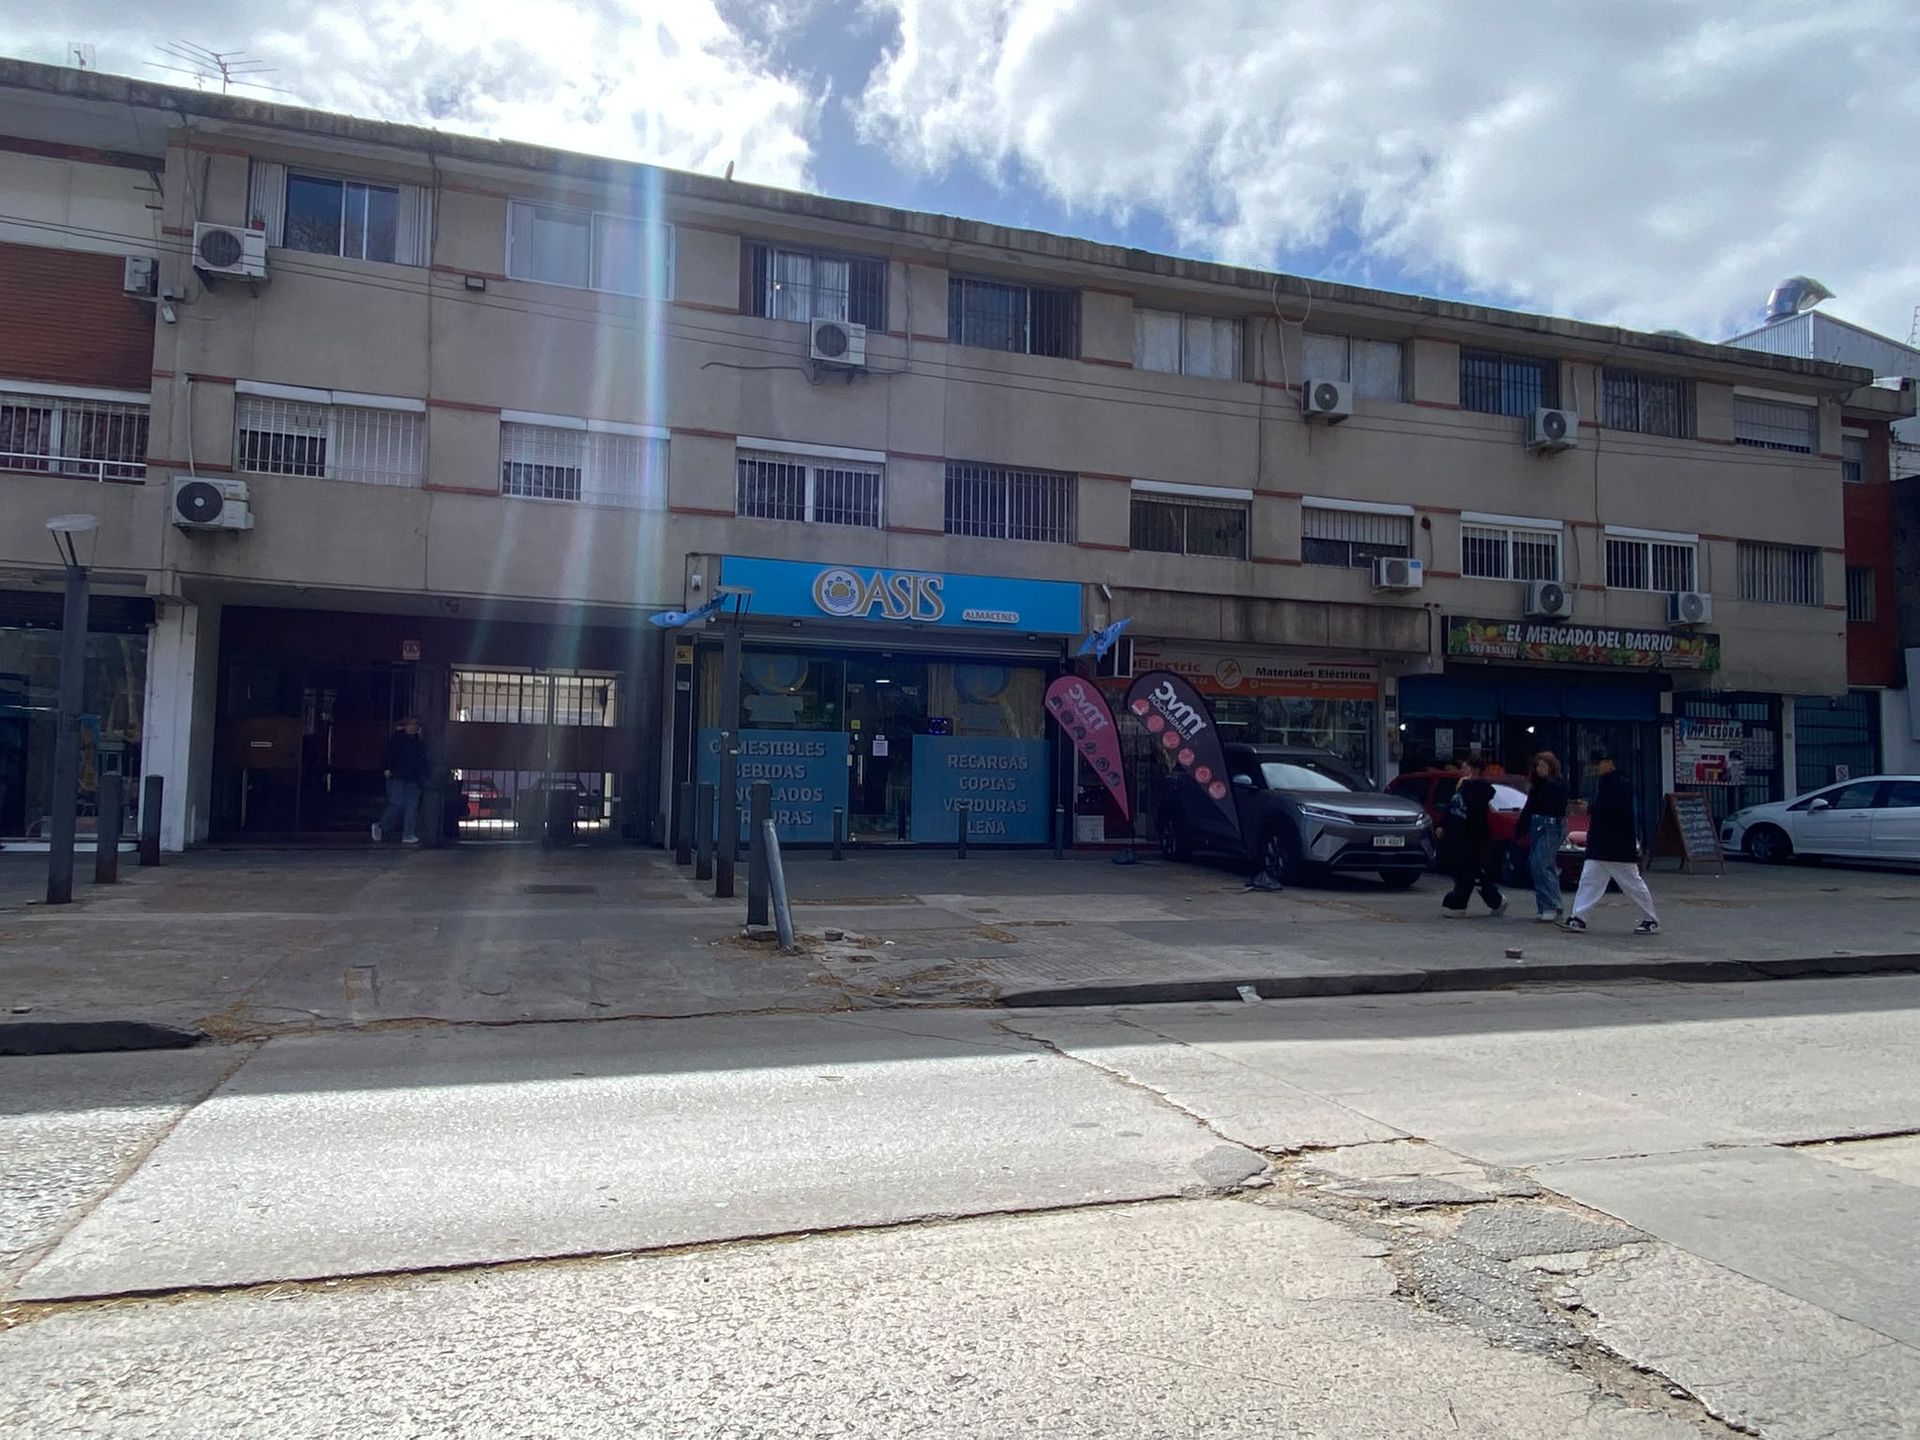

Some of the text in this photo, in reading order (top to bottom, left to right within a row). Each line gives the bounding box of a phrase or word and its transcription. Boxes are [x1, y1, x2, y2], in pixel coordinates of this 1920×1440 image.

[813, 568, 945, 621] OASIS
[963, 610, 1018, 622] ALMACENES
[1506, 624, 1673, 651] EL MERCADO DEL BARRIO
[1255, 667, 1371, 680] Materiales Eléctricos
[710, 740, 826, 757] CMESTIBLES
[947, 754, 1029, 771] RECARGAS
[959, 776, 1018, 792] COPIAS
[943, 798, 1027, 814] VERDURAS
[967, 817, 1007, 835] LEÑA
